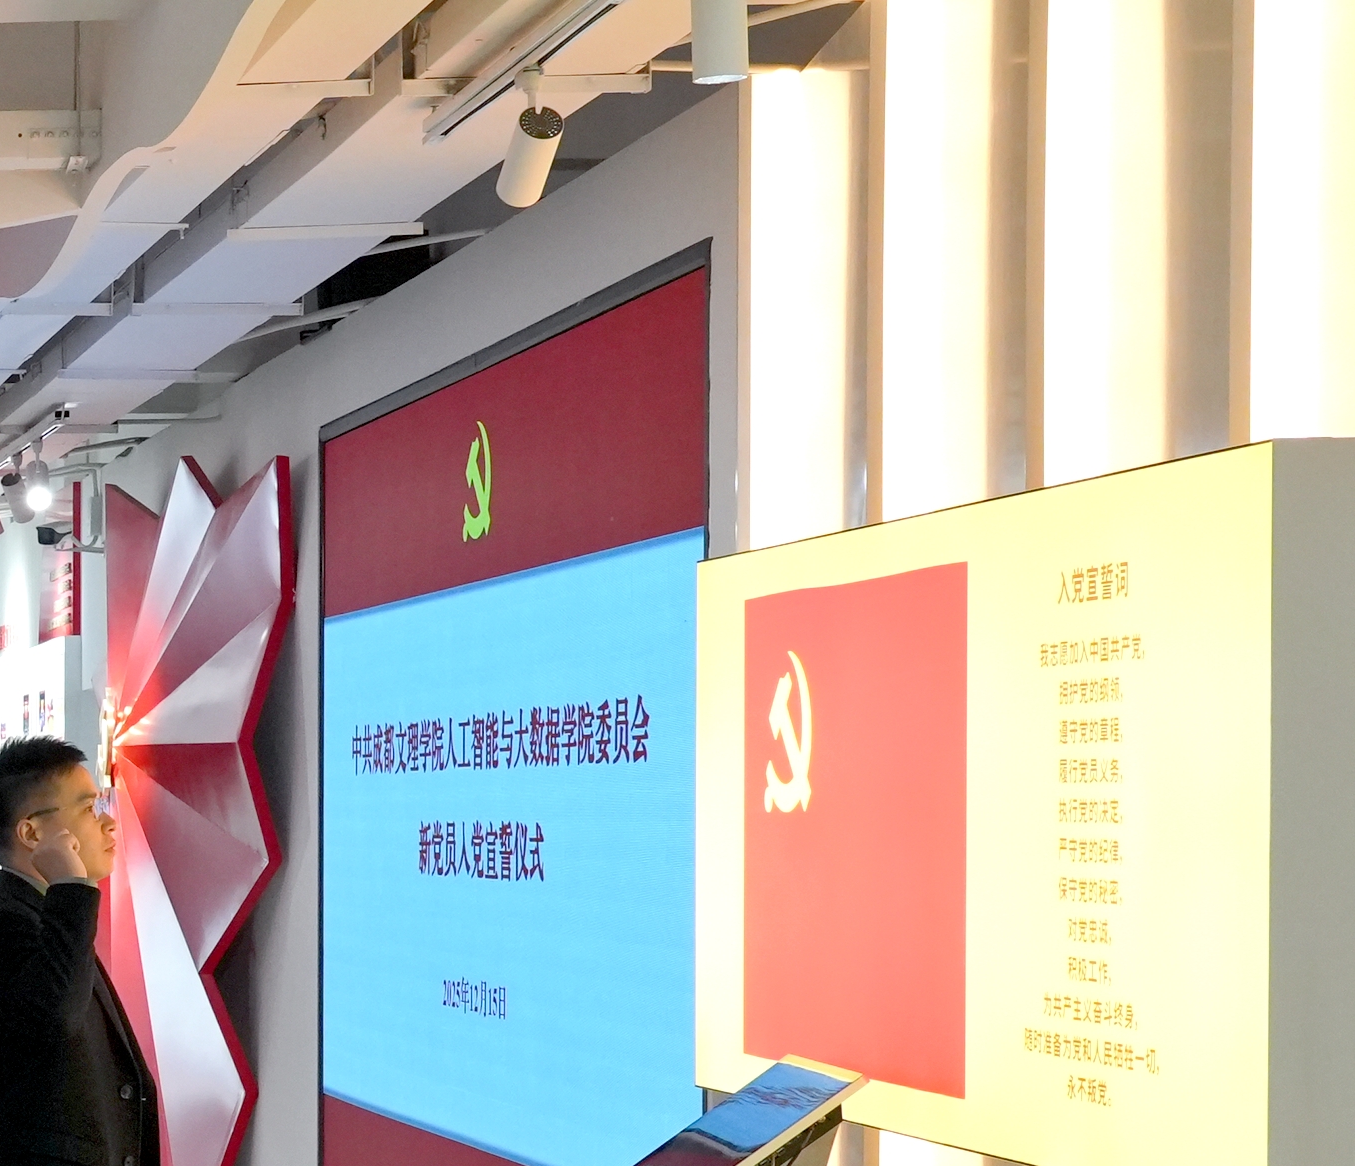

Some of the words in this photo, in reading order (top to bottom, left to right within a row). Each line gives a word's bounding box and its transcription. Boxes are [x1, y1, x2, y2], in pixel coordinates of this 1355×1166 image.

[1057, 562, 1129, 604] 入党宣誓词
[1040, 634, 1146, 667] 我志愿加入中国共产党，
[351, 694, 650, 776] 中共成都文理学院人工智能与大数据学院委员会
[418, 819, 545, 882] 新党员入党宣誓仪式
[442, 976, 506, 1020] 2025年12月15日
